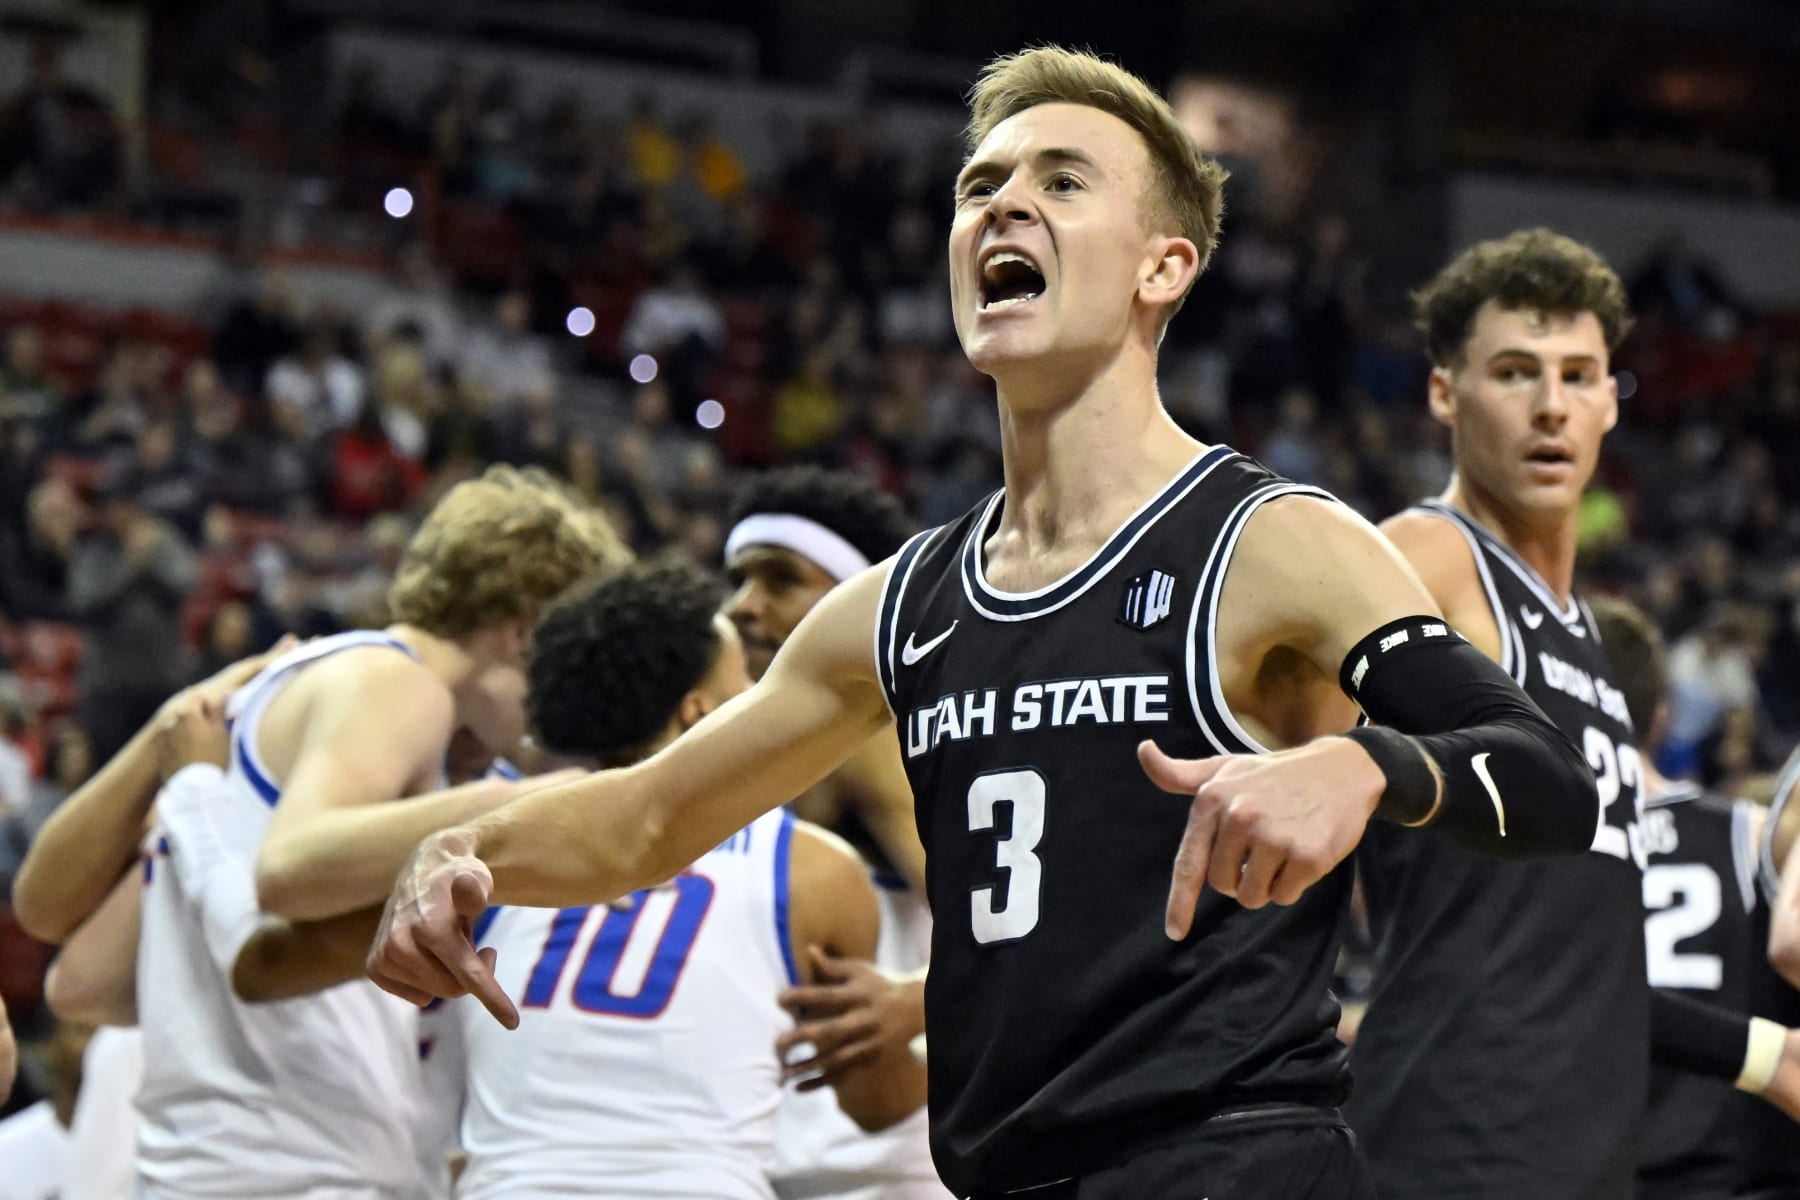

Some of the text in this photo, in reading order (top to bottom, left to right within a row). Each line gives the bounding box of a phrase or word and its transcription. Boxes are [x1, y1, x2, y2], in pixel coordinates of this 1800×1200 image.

[907, 674, 1170, 759] UTAH STATE
[967, 768, 1048, 945] 3
[520, 872, 716, 1021] 10
